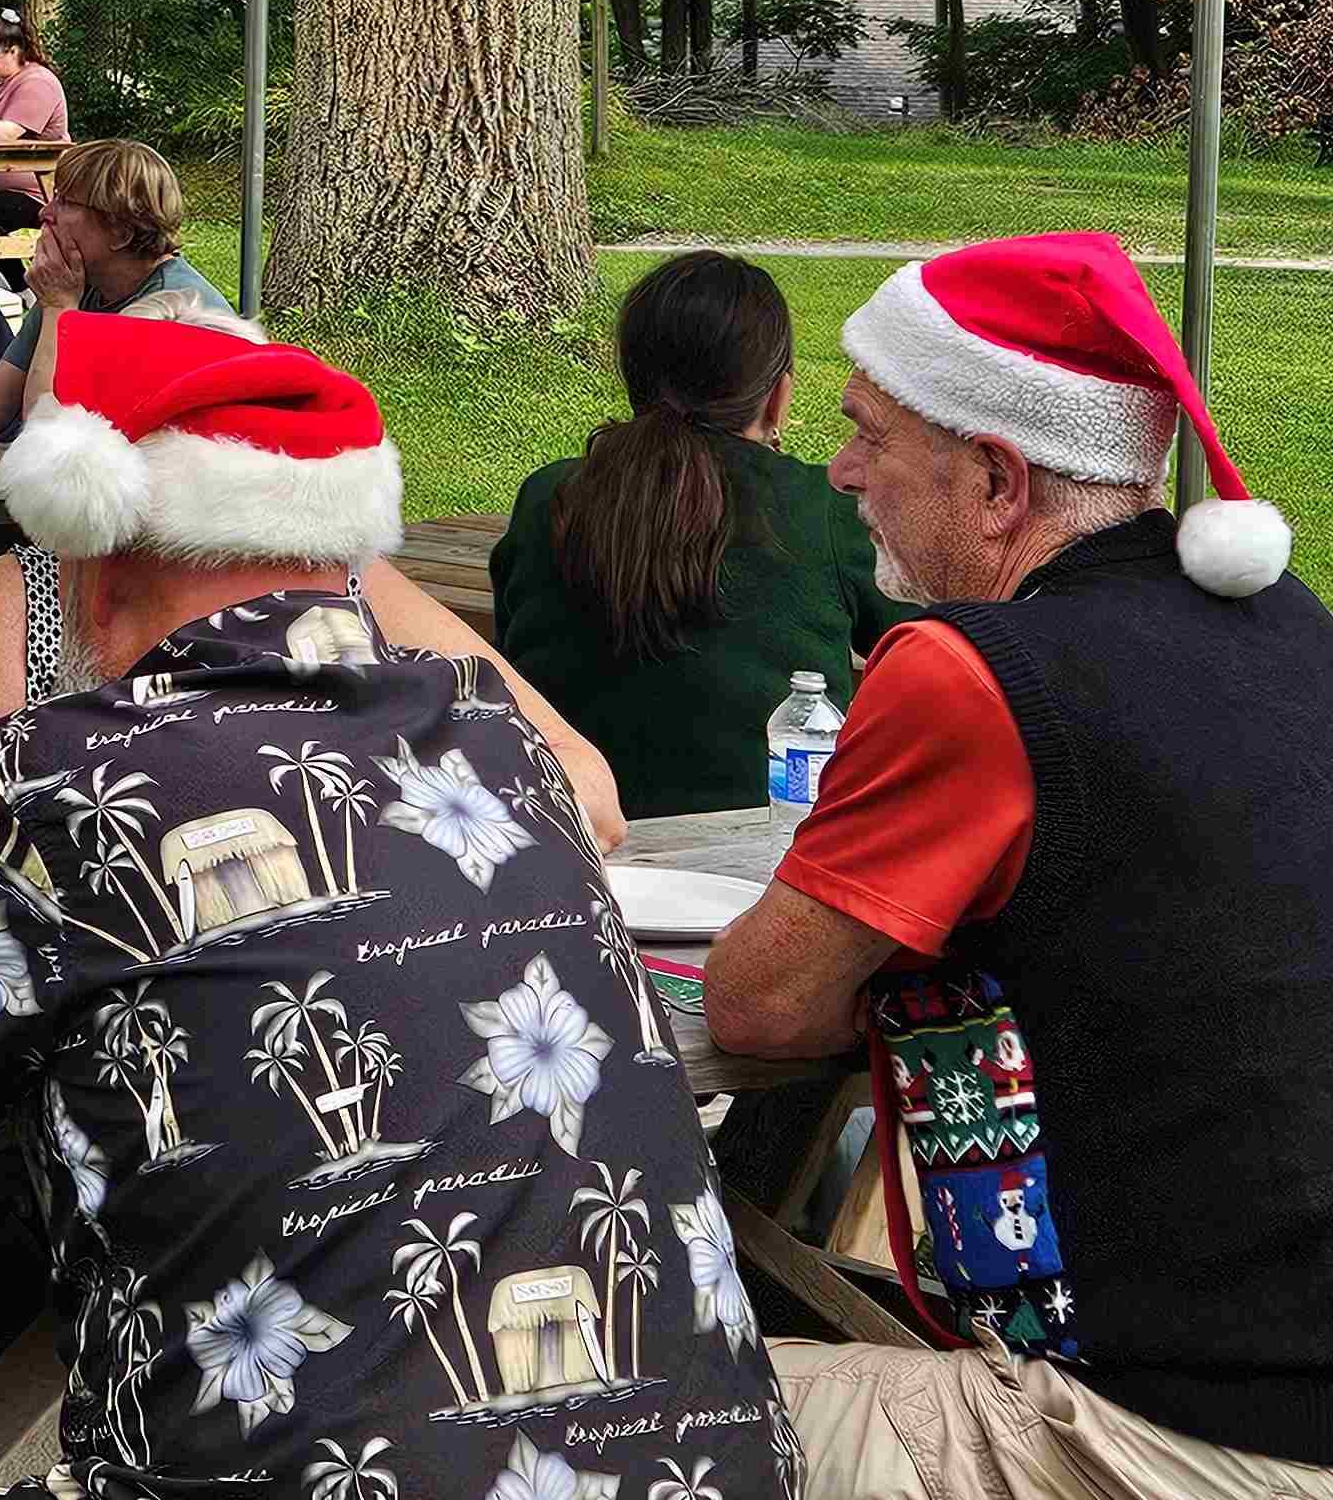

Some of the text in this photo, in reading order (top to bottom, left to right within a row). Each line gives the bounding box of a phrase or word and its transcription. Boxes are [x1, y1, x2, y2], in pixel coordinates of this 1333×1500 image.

[86, 696, 339, 751] tropical paradise
[356, 910, 587, 966] tropical paradise
[282, 1157, 543, 1237] tropical paradise
